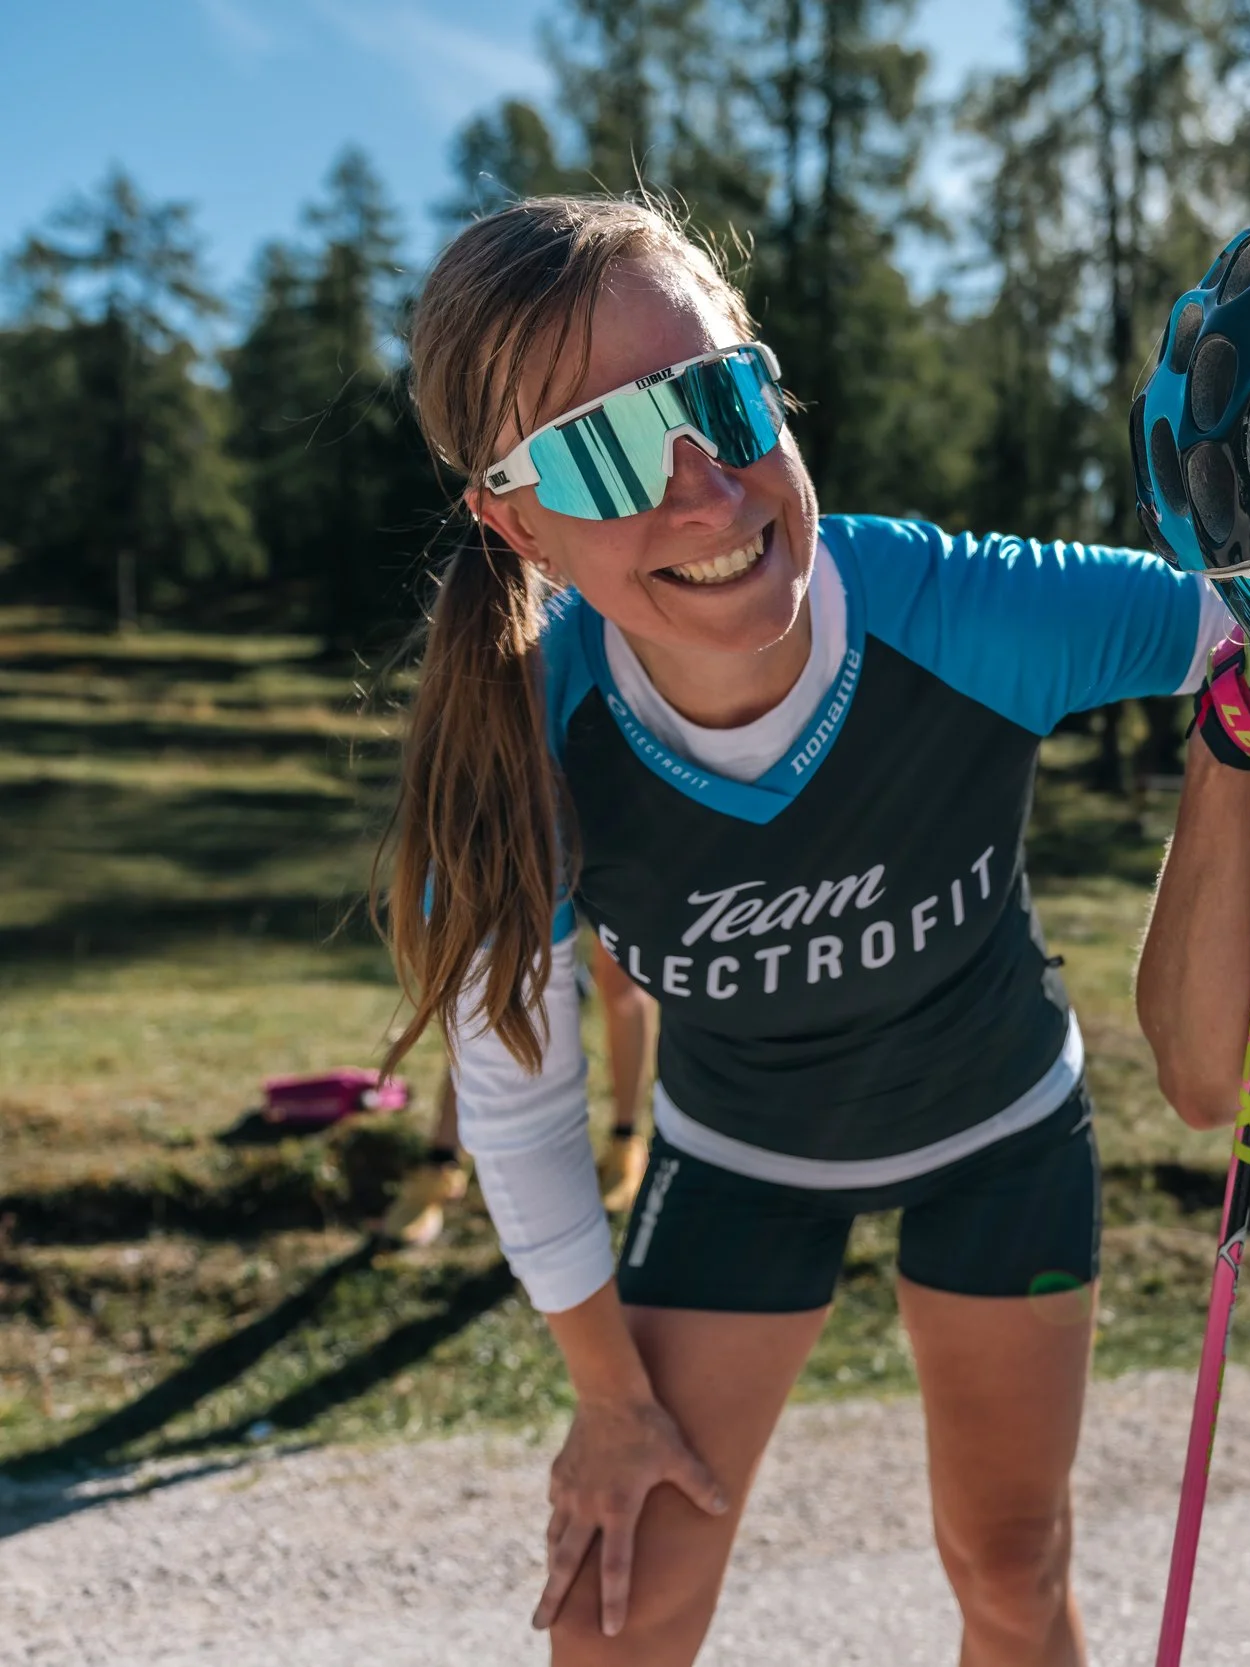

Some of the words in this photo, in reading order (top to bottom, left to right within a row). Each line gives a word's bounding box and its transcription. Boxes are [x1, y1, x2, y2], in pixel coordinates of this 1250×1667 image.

[623, 720, 710, 790] ELECTROFIT
[790, 648, 861, 776] noname
[600, 845, 995, 1000] ELECTROFIT
[681, 863, 887, 947] Team
